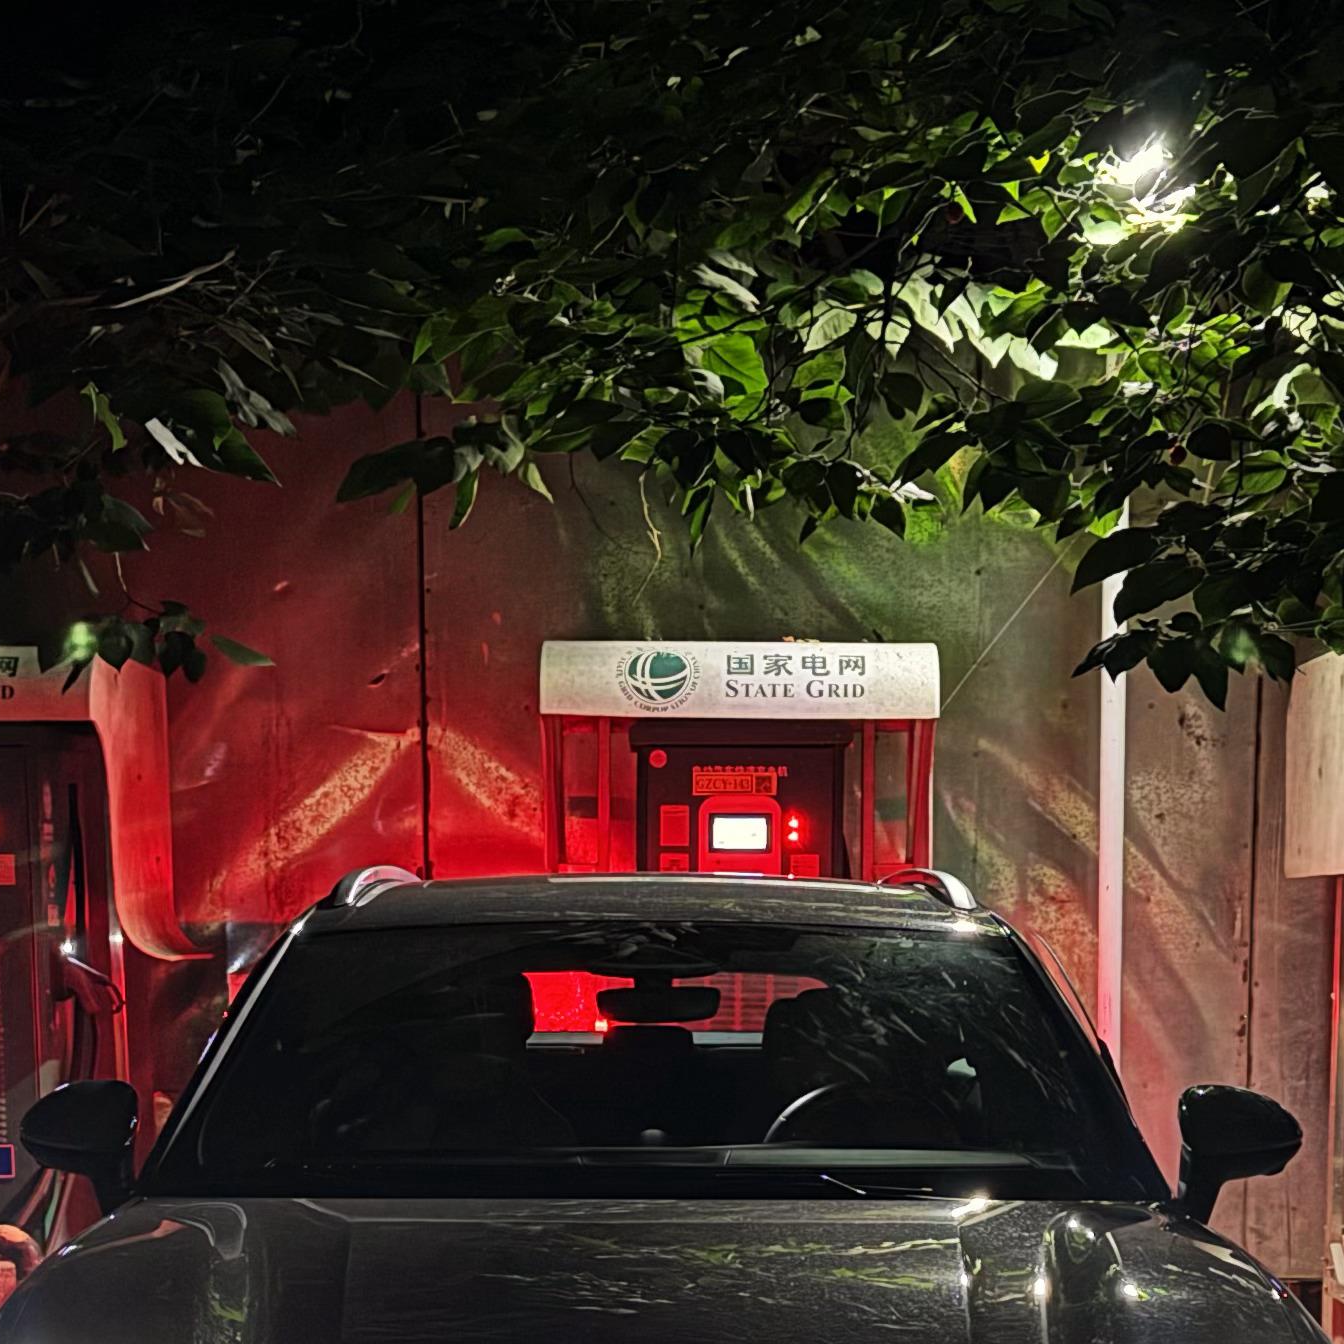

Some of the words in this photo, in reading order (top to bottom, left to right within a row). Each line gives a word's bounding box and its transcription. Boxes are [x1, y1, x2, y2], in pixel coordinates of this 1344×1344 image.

[726, 653, 866, 677] 国家电网
[725, 679, 795, 698] STATE
[806, 679, 865, 698] GRID
